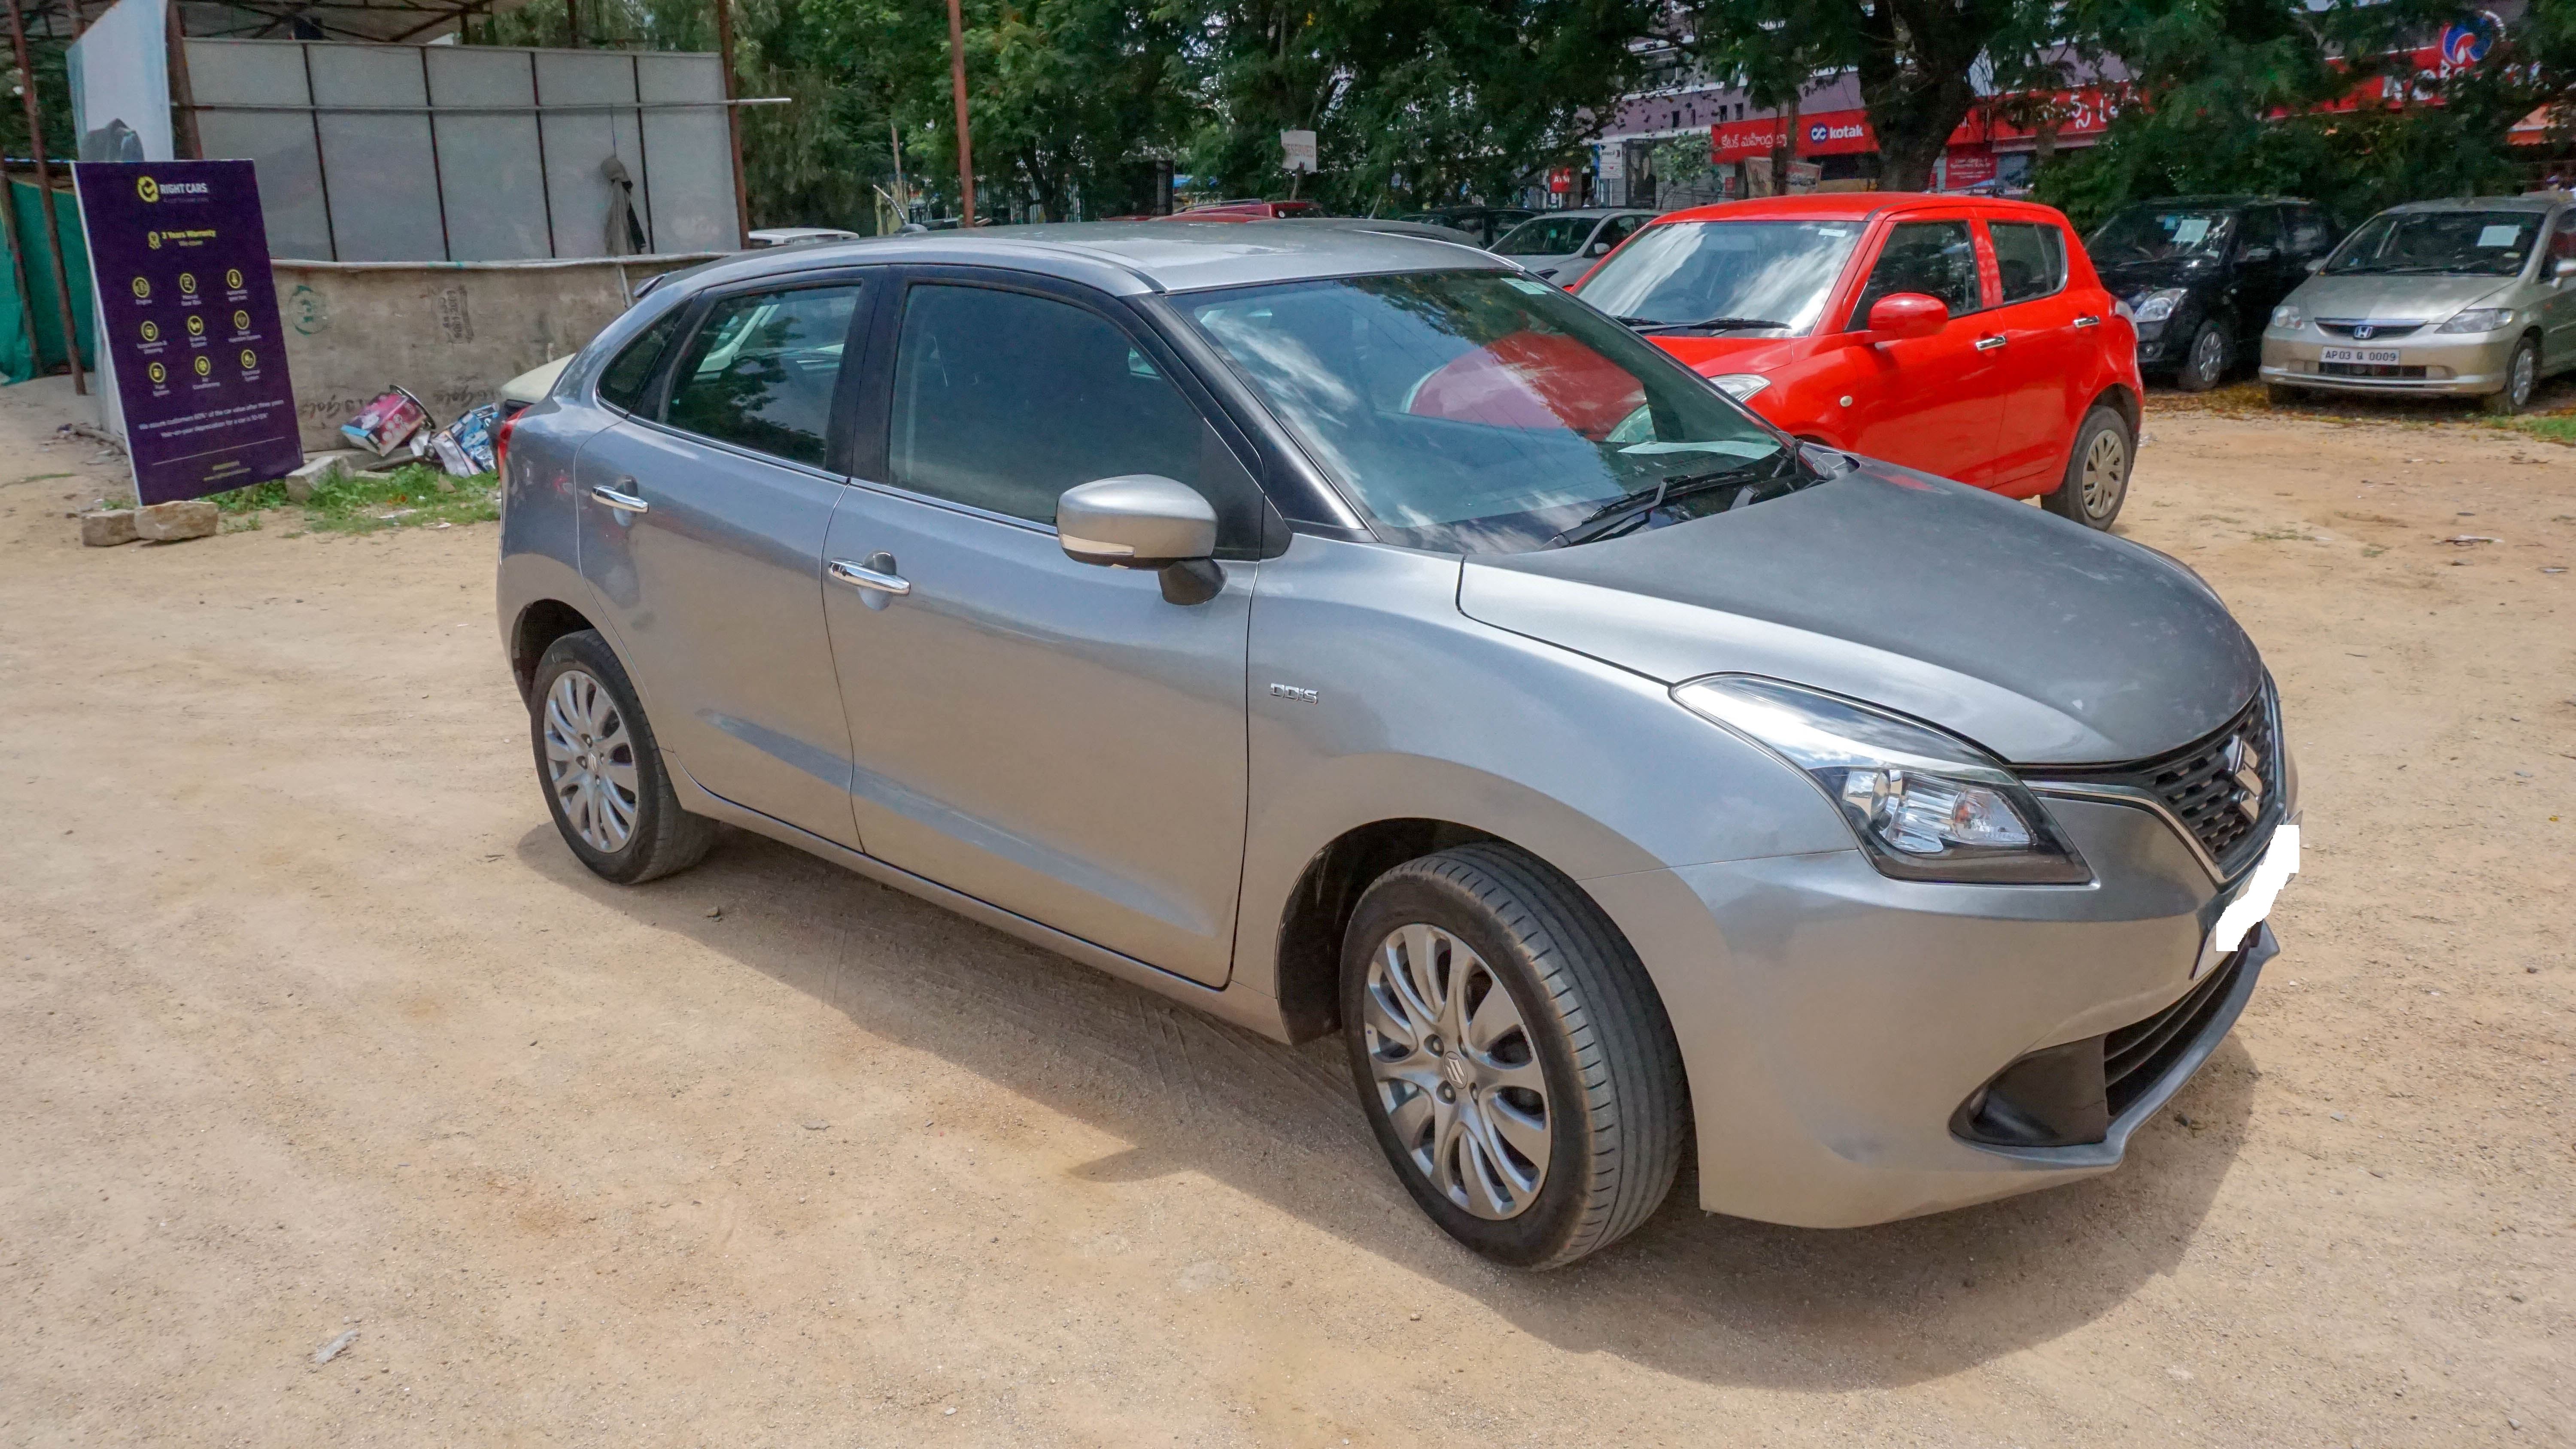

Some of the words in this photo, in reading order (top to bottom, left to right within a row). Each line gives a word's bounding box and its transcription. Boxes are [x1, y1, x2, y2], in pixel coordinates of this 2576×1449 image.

[1830, 124, 1863, 139] kotak
[159, 184, 185, 194] RIGHT
[185, 183, 208, 193] CARS
[2369, 352, 2396, 361] 0009
